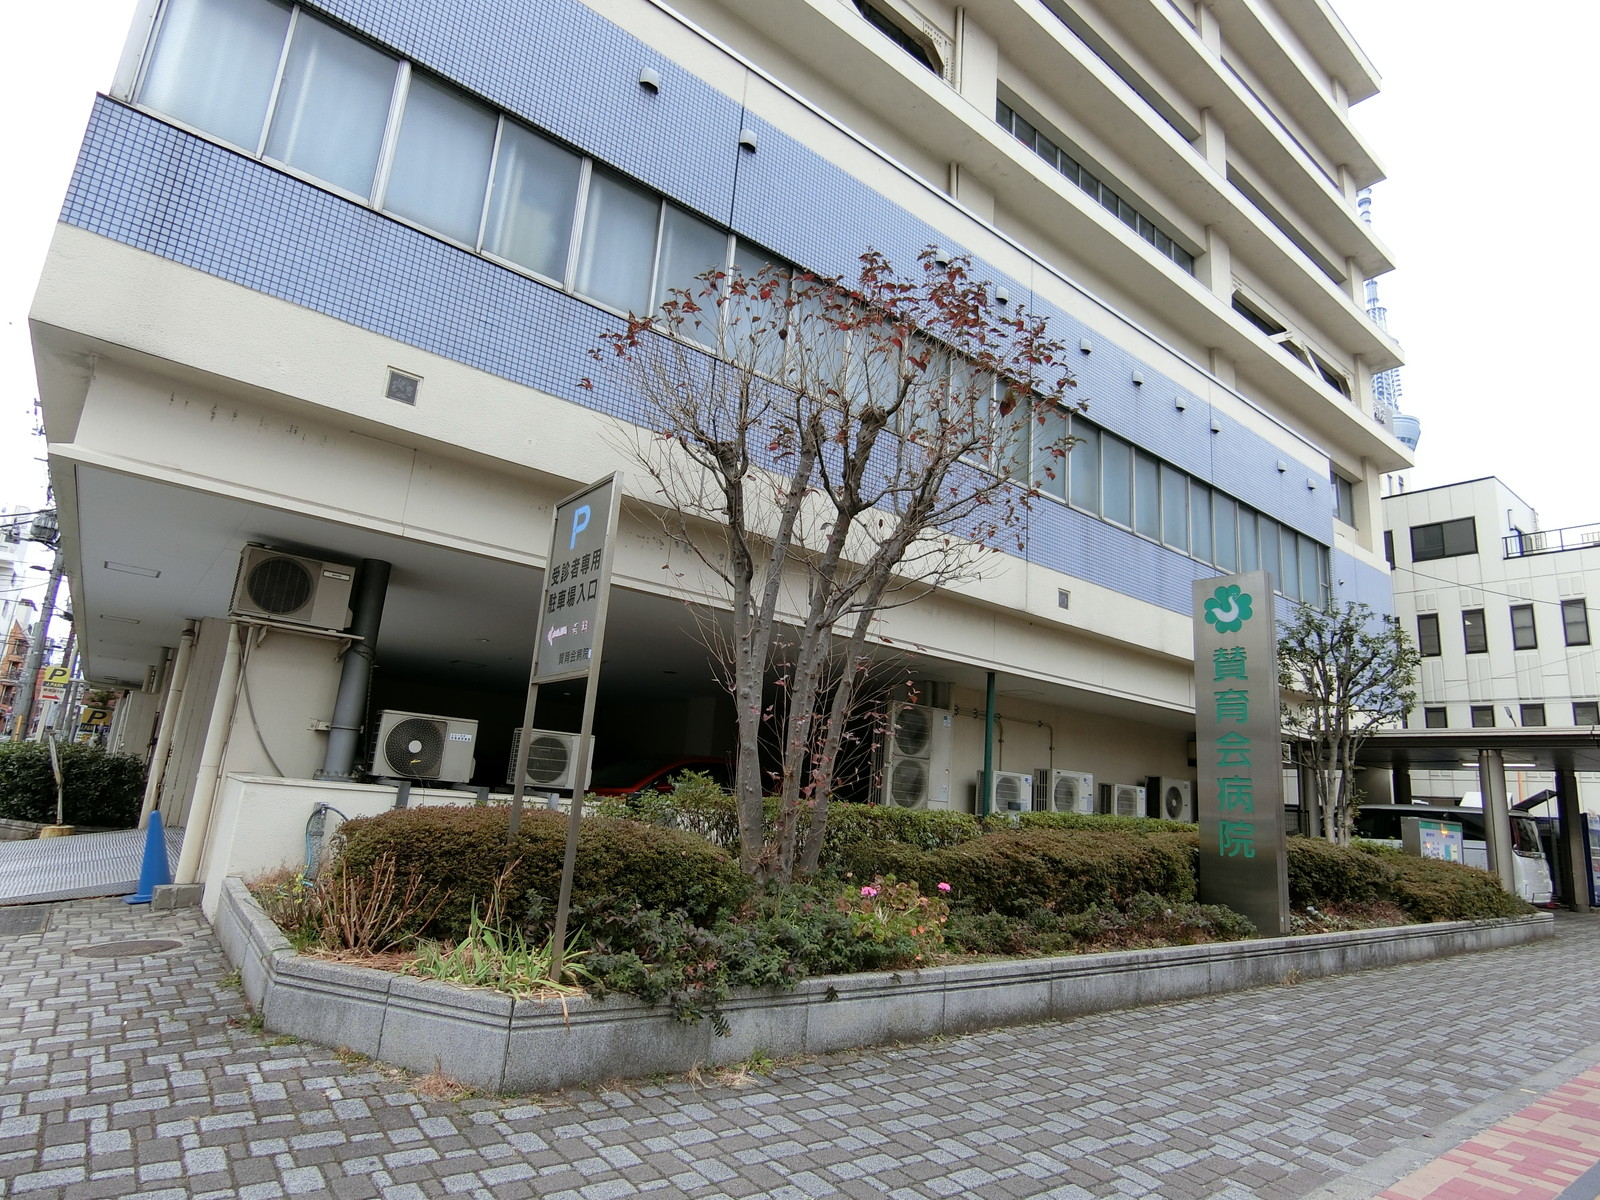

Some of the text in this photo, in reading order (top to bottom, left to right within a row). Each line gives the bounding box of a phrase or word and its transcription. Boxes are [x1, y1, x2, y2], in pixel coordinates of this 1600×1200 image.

[569, 504, 591, 550] P
[551, 548, 602, 587] 受診者専用
[547, 579, 598, 613] 駐車場入口
[48, 668, 67, 680] P
[87, 710, 107, 723] P
[1212, 645, 1255, 858] 賛育会病院
